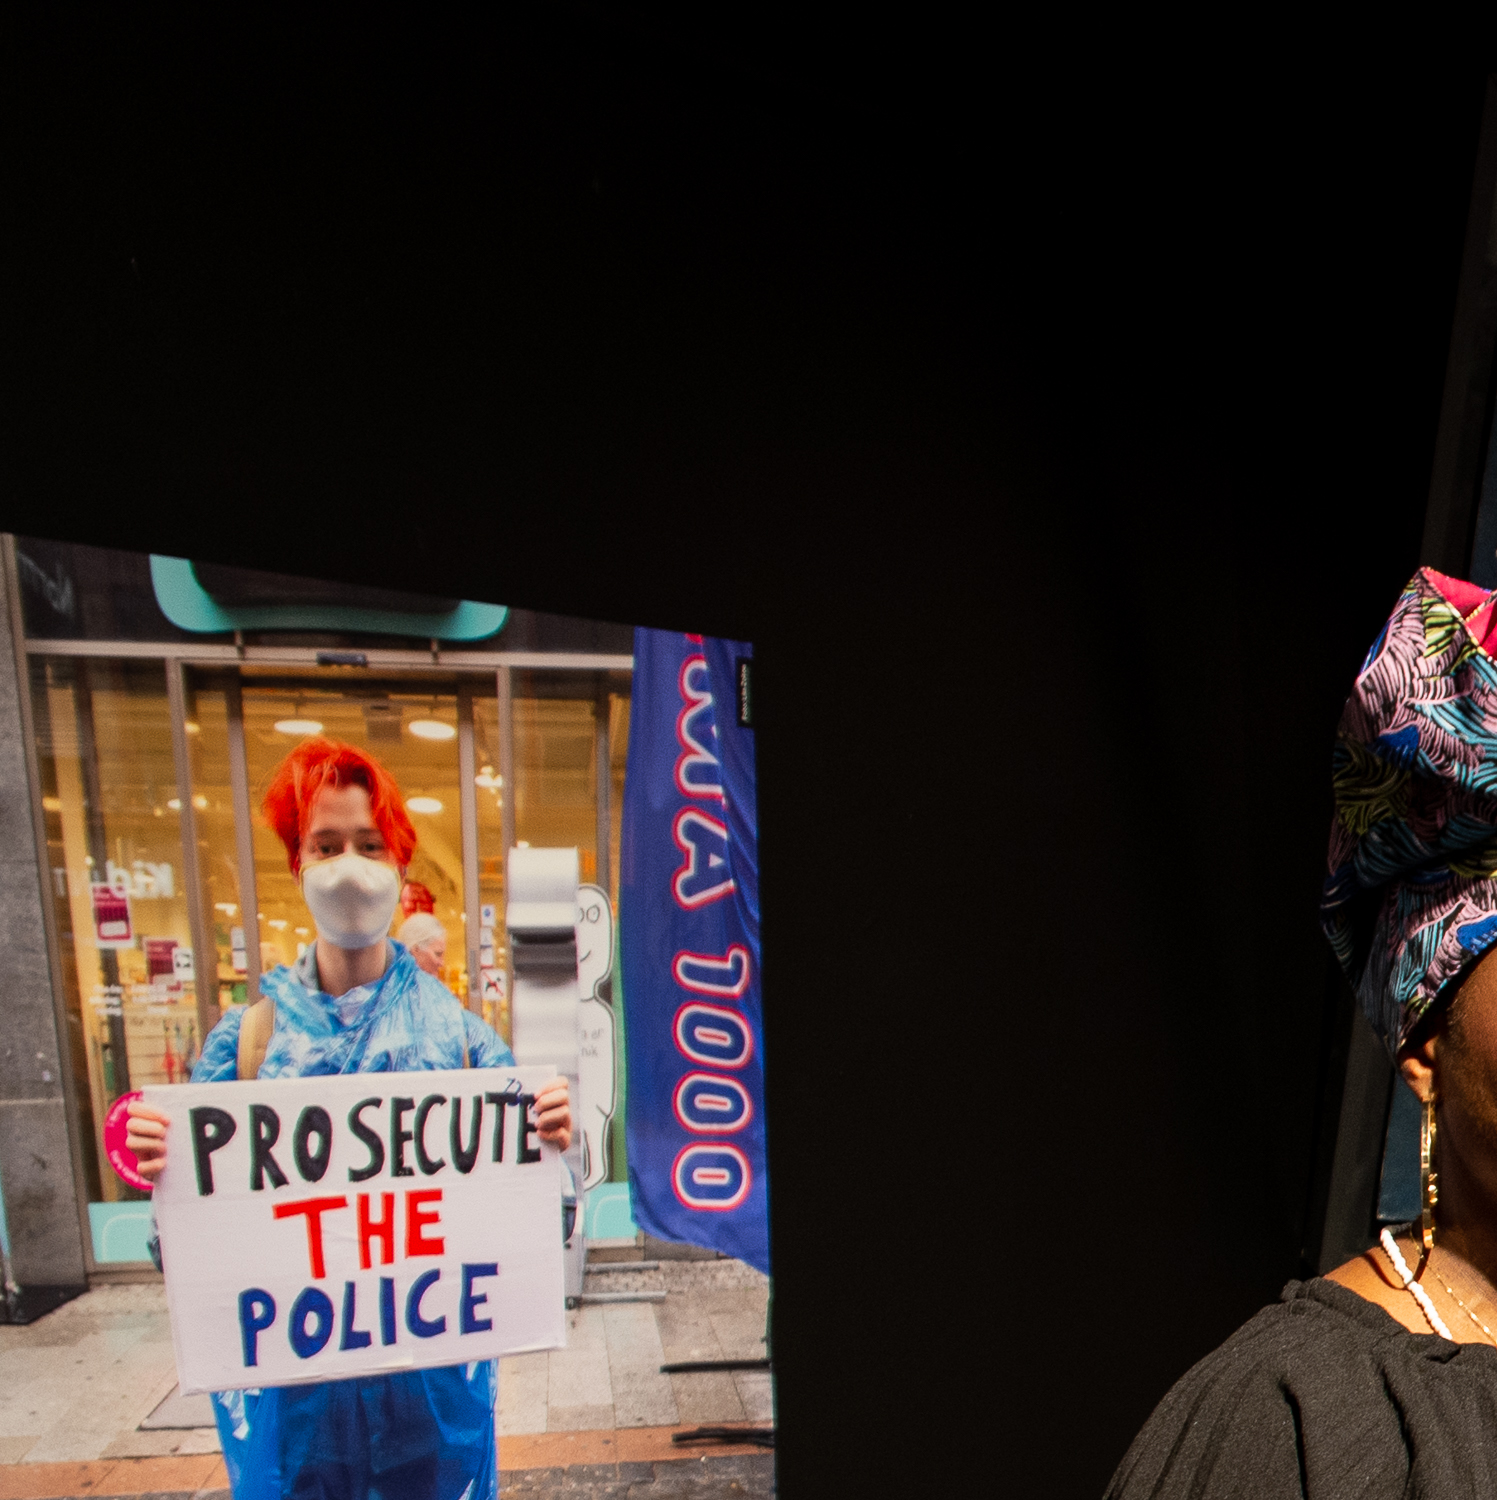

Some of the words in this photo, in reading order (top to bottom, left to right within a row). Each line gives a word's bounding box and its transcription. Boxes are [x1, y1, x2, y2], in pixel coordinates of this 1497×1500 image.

[672, 943, 751, 1211] 1000
[189, 1092, 542, 1196] PROSECUTE
[272, 1189, 446, 1279] THE
[237, 1263, 499, 1367] POLICE
